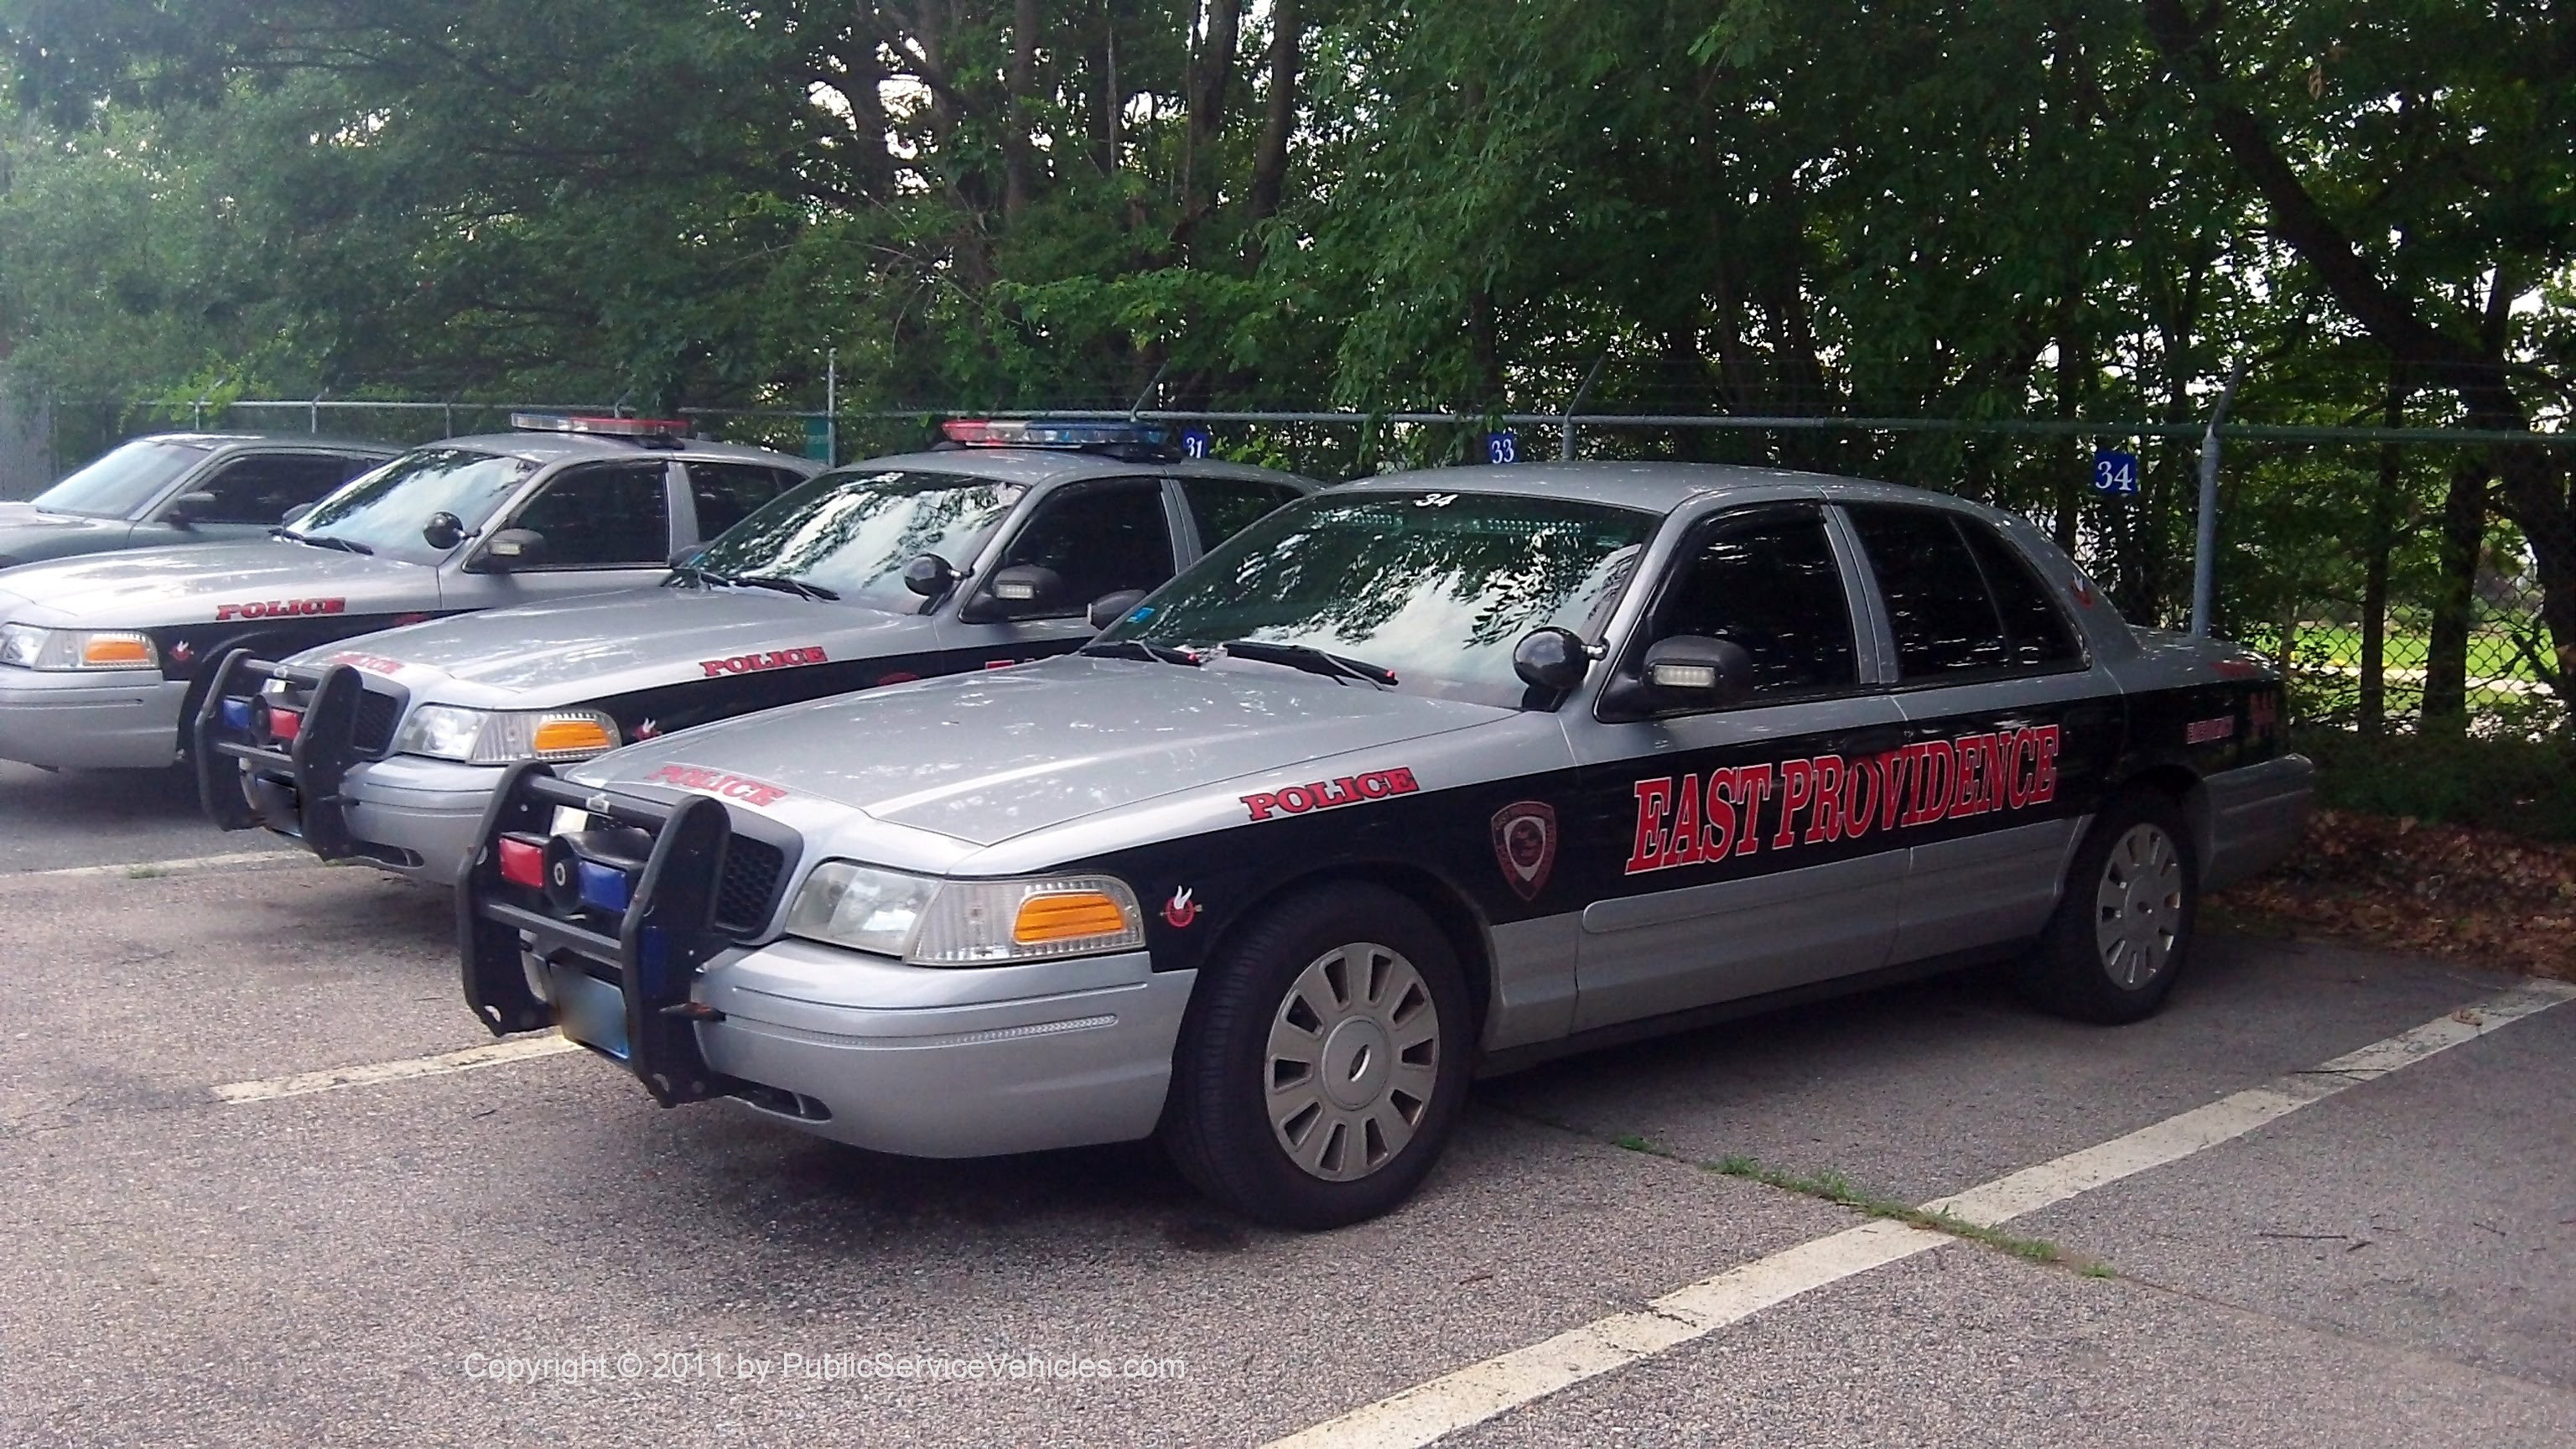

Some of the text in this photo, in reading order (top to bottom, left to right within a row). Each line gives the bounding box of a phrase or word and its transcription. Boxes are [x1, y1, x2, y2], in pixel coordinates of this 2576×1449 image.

[1186, 437, 1202, 459] 31
[1492, 439, 1514, 464] 33
[2096, 460, 2132, 491] 34
[1413, 493, 1458, 507] 34
[216, 597, 345, 621] POLICE
[699, 646, 828, 677] POLICE
[643, 765, 788, 807] POLICE
[1239, 766, 1420, 821] POLICE
[1625, 763, 1772, 875] EAST
[1772, 724, 2059, 850] PROVIDENCE
